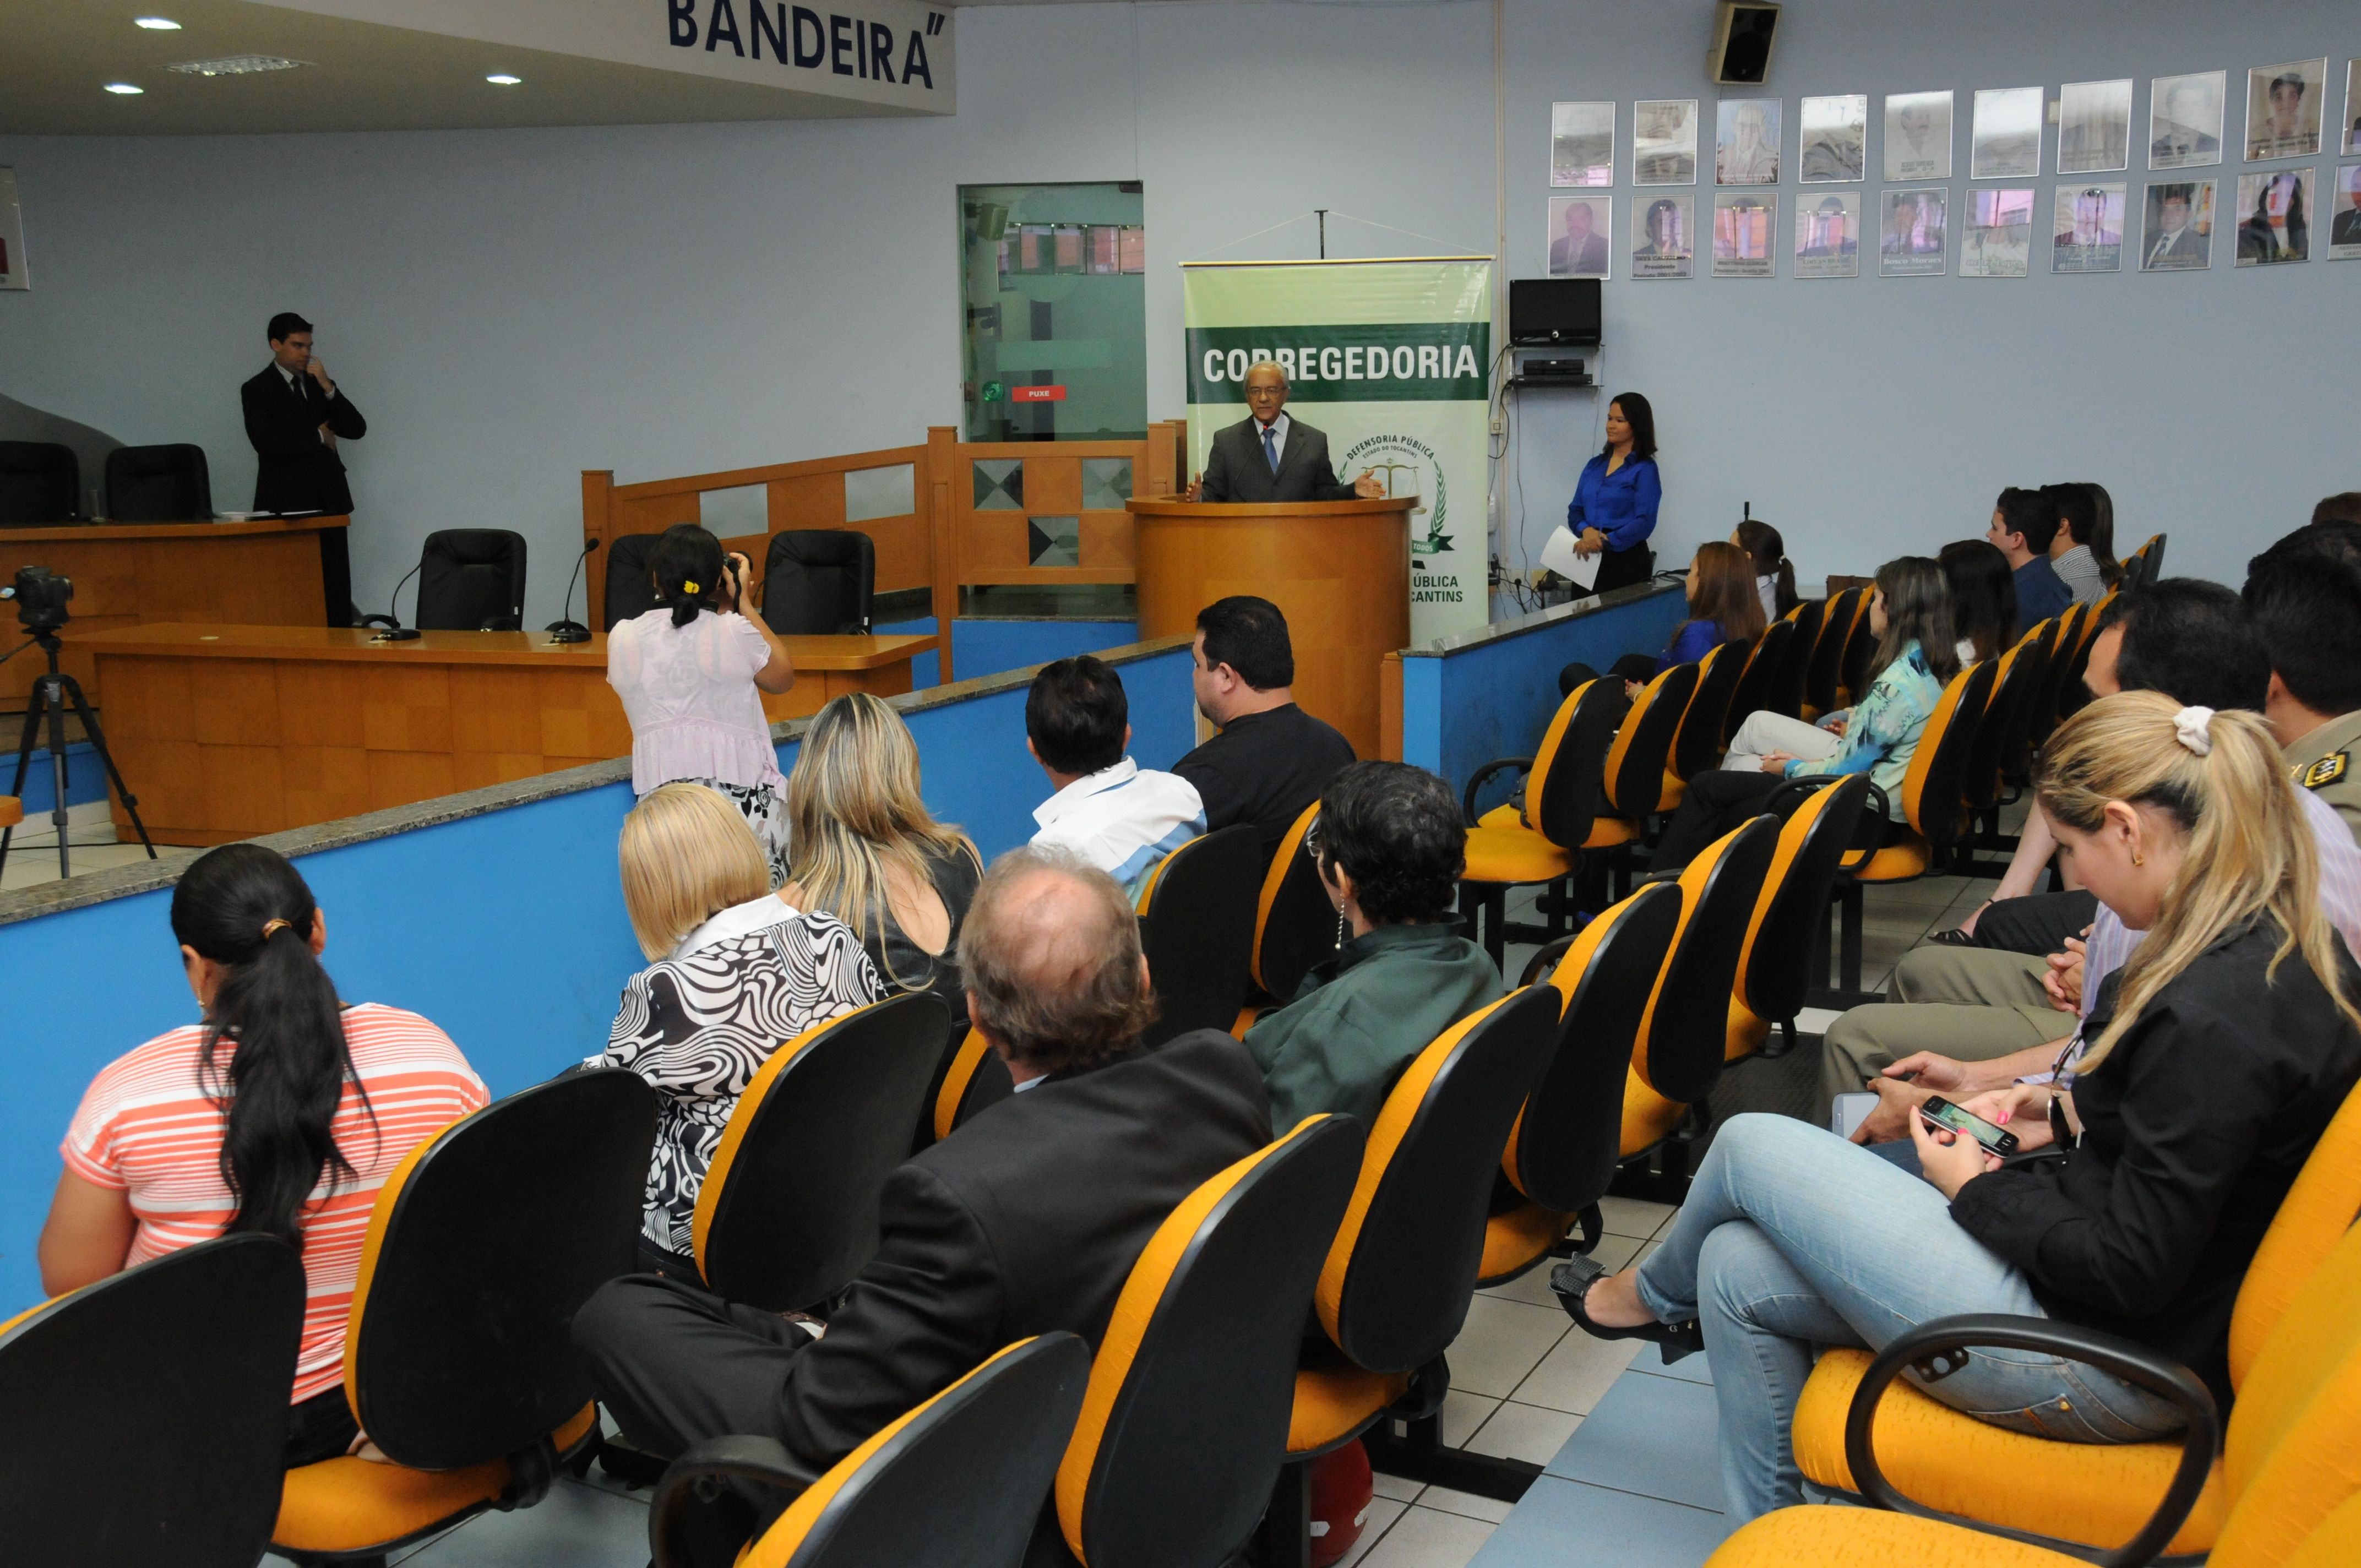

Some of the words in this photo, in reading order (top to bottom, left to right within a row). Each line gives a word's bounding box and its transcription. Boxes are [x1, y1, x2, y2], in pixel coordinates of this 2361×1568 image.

[667, 0, 945, 89] BANDEIRA"
[1346, 434, 1397, 460] DEFENSORIA
[1401, 435, 1434, 460] PÚBLICA
[1363, 447, 1380, 459] ESTADO
[1391, 445, 1417, 459] TOCANTINS
[1413, 543, 1433, 552] TODOS
[1413, 573, 1458, 587] ÚBLICA
